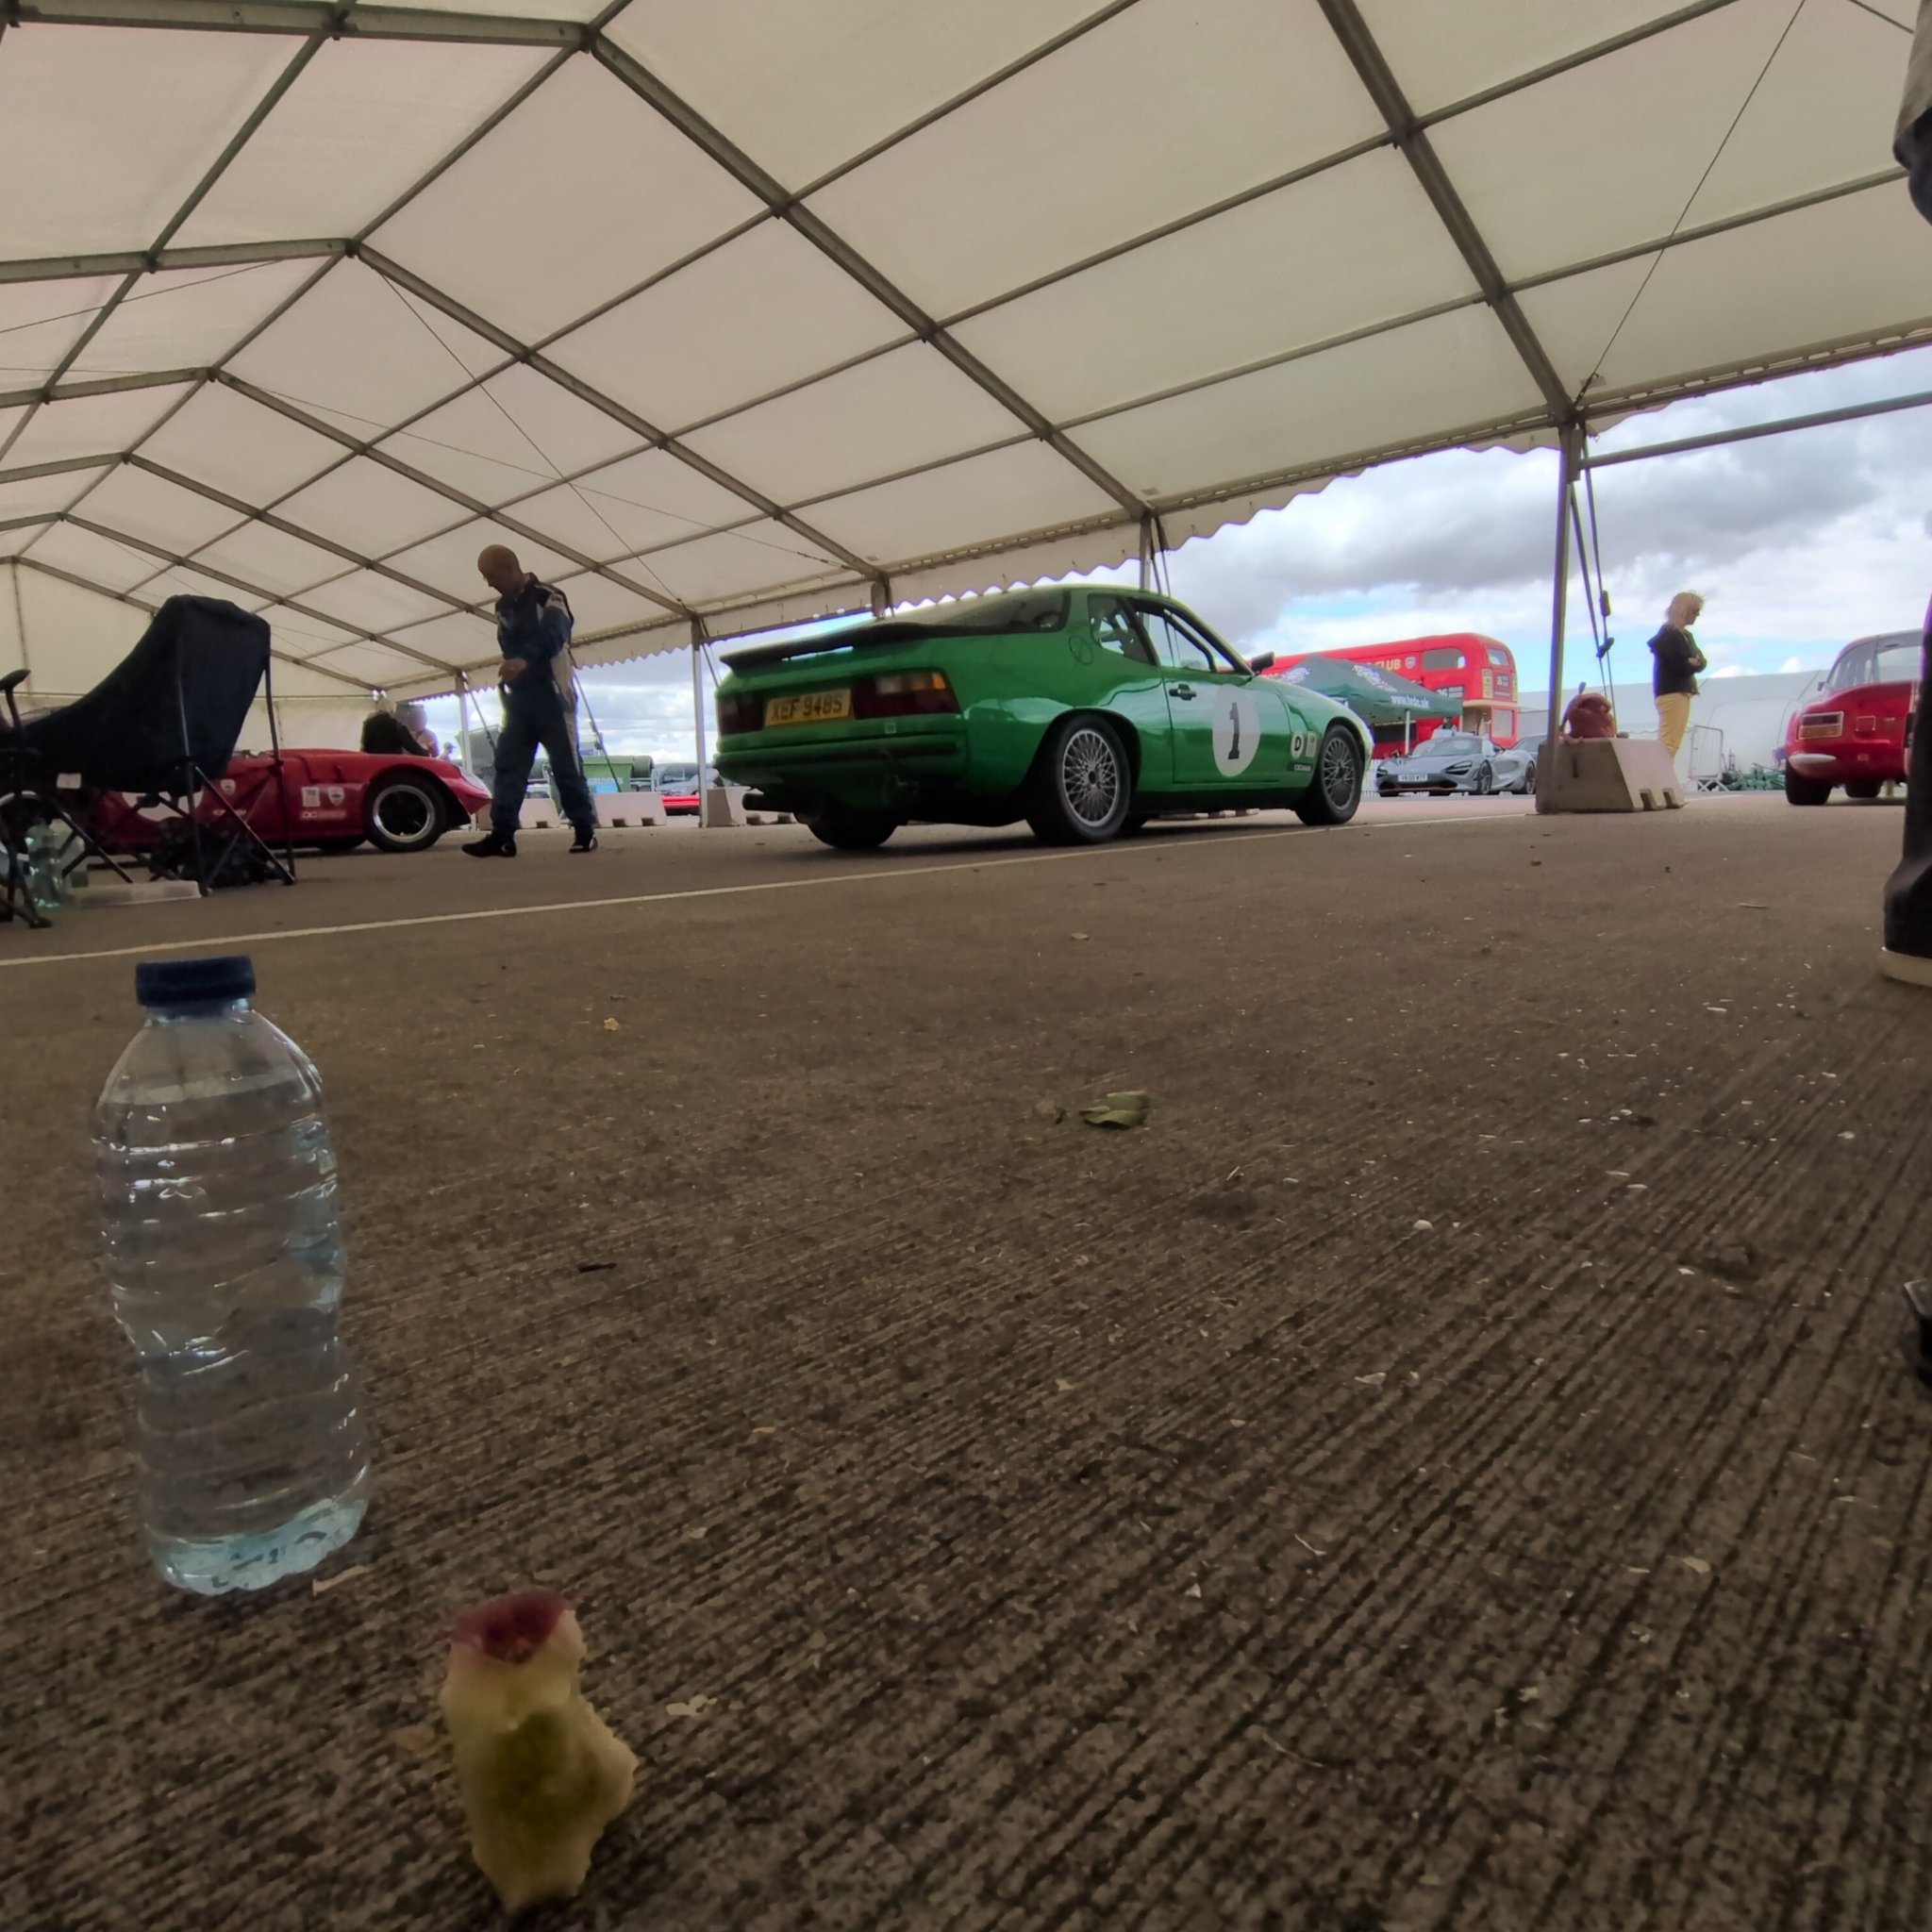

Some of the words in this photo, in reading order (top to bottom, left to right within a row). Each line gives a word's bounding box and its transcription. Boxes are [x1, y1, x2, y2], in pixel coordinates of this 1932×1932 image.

[771, 697, 801, 722] XEF
[1228, 702, 1240, 760] 1
[1294, 736, 1302, 752] D
